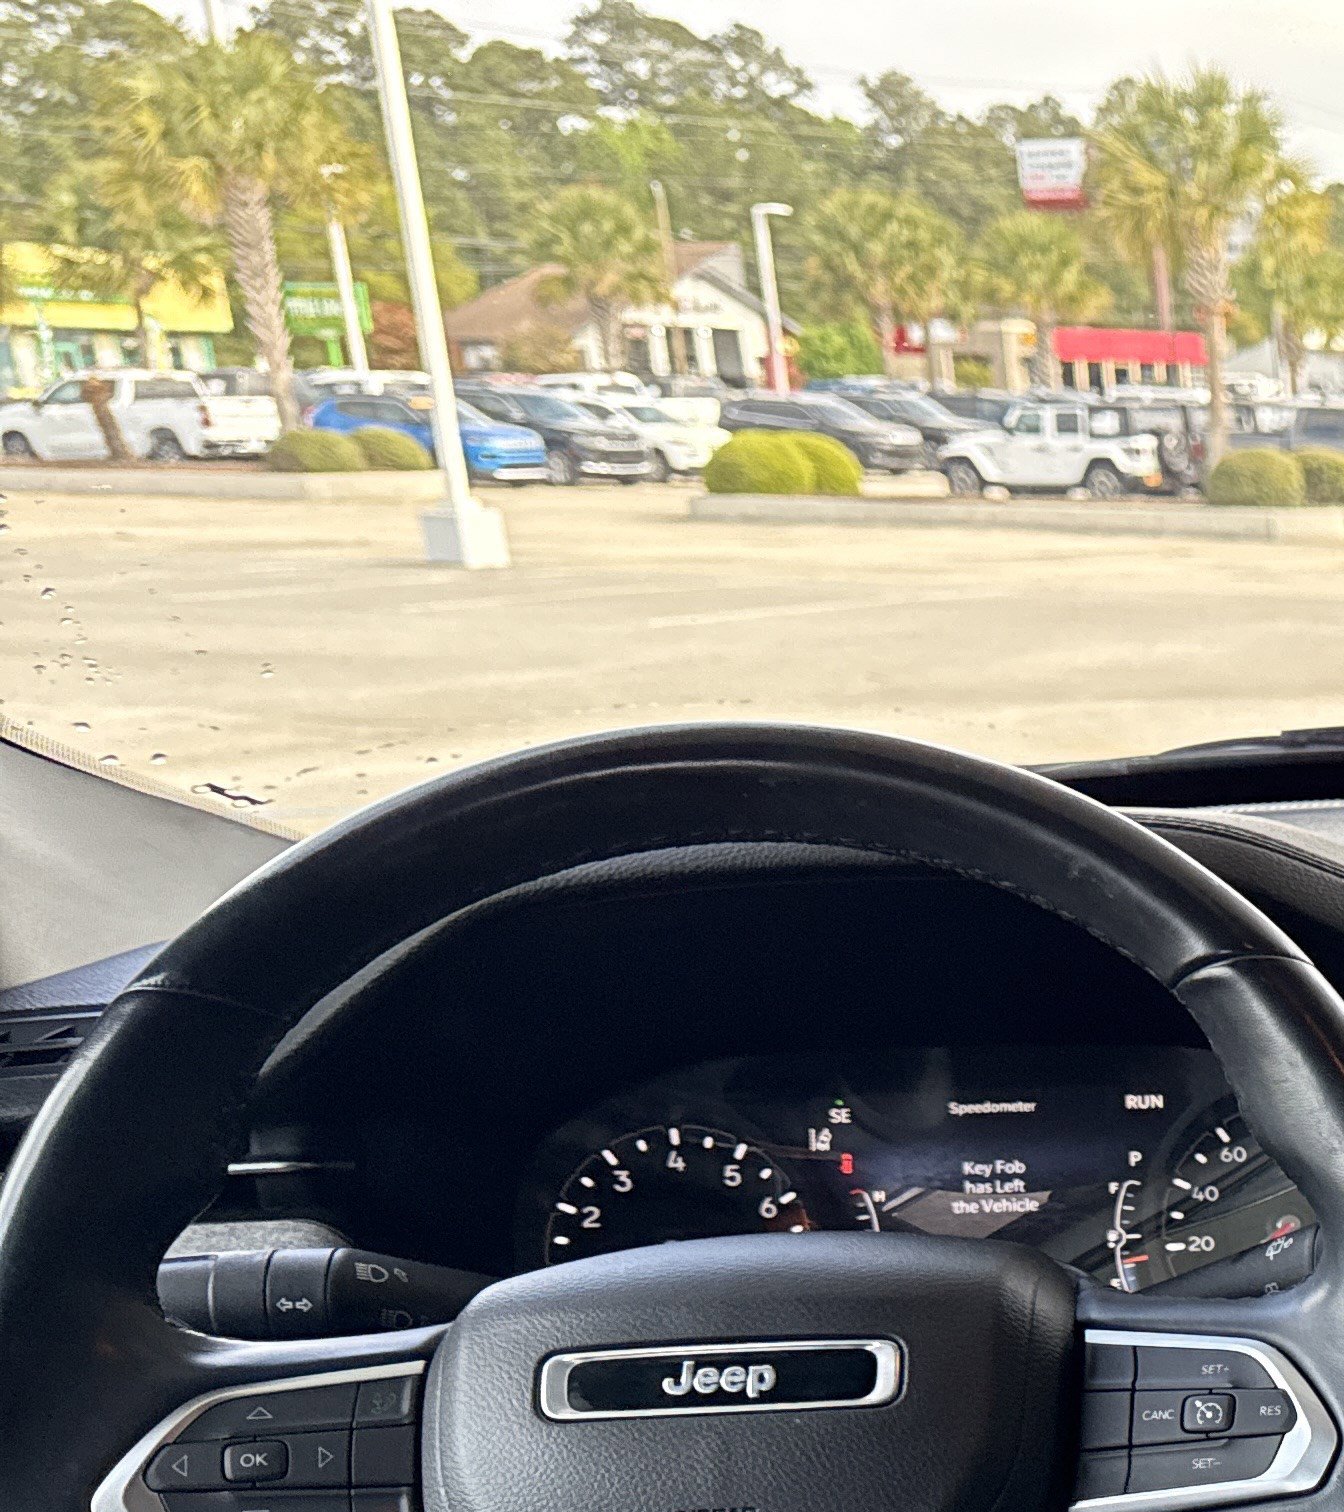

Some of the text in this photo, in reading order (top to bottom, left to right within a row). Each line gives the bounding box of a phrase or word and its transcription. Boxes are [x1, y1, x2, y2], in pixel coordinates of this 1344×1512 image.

[948, 1100, 1037, 1116] Speedometer
[1124, 1094, 1164, 1110] RUN
[828, 1107, 852, 1124] SE
[666, 1150, 686, 1172] 4
[1128, 1150, 1142, 1167] P
[1220, 1147, 1247, 1164] 60
[723, 1164, 743, 1187] 5
[962, 1160, 1026, 1178] Key Fob
[613, 1171, 634, 1194] 3
[963, 1179, 1026, 1194] has Left
[1191, 1186, 1219, 1202] 40
[758, 1200, 778, 1219] 6
[952, 1197, 1040, 1214] the Vehicle
[580, 1206, 602, 1229] 2
[1188, 1236, 1215, 1252] 20
[661, 1360, 777, 1398] Jeep
[1142, 1409, 1175, 1421] CANC
[1259, 1405, 1282, 1416] RES
[240, 1453, 268, 1467] OK
